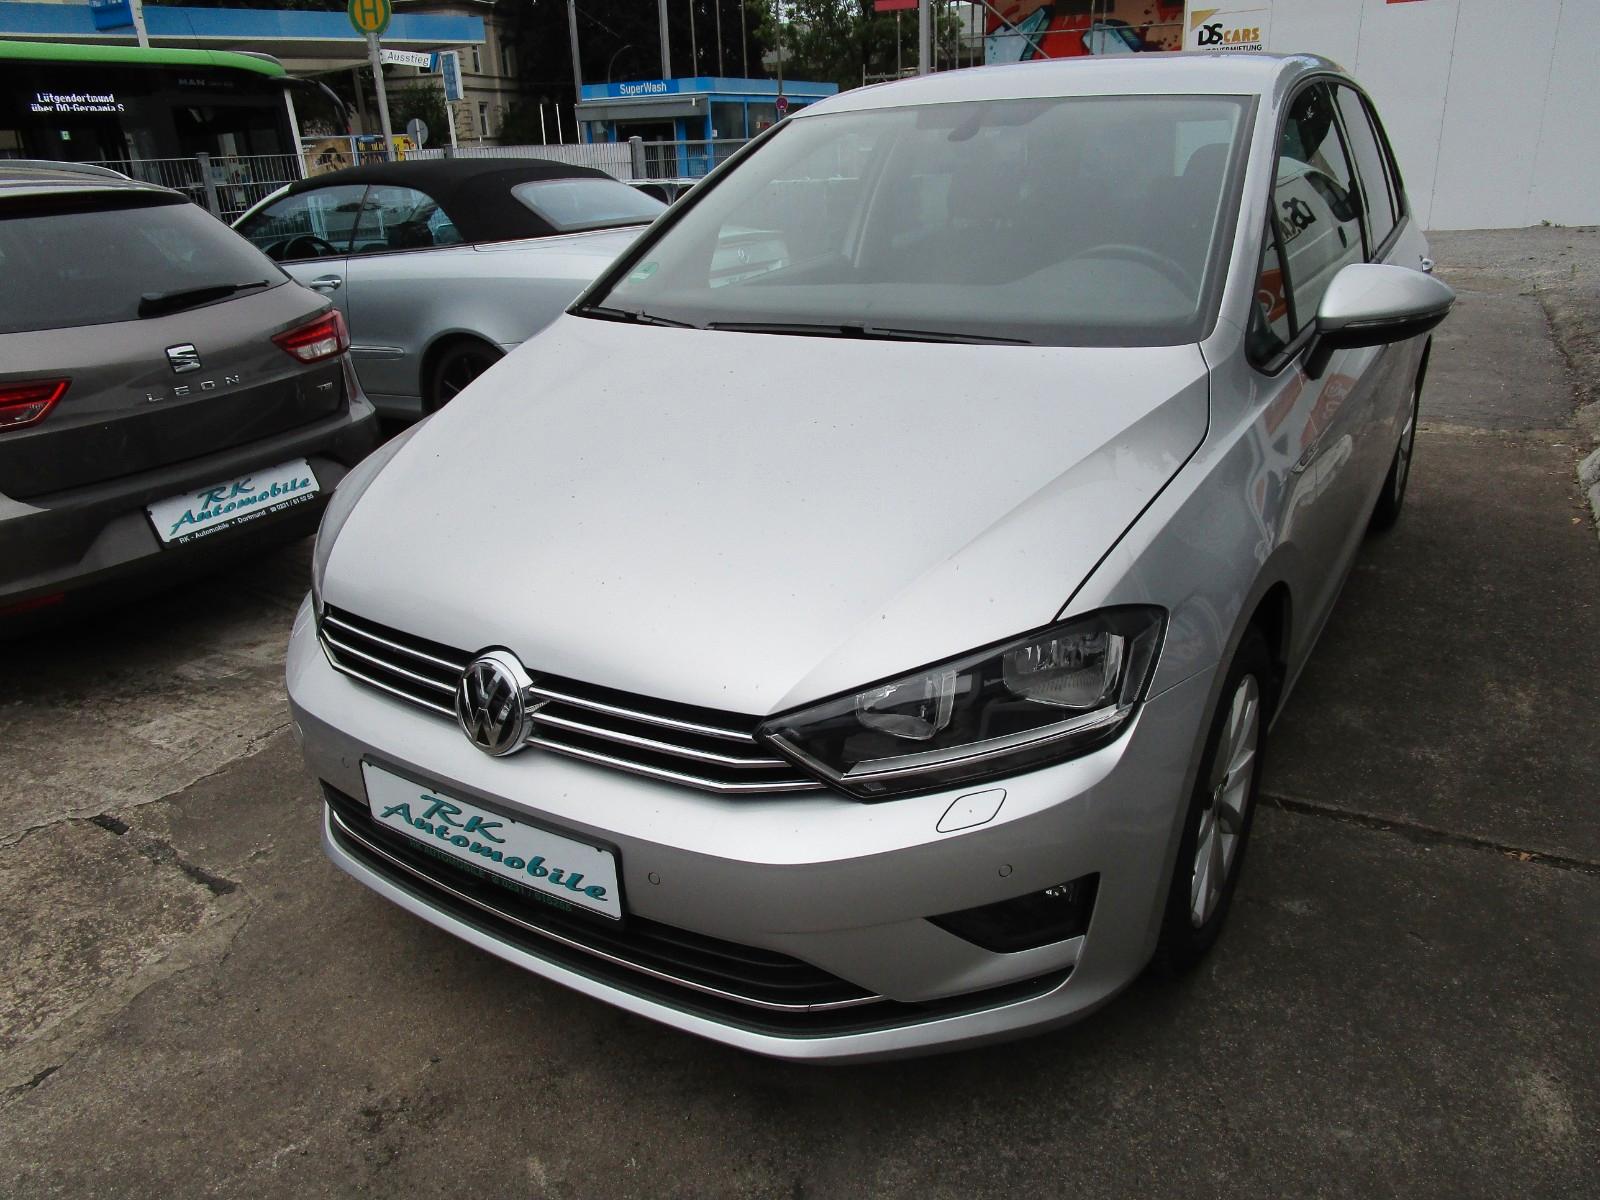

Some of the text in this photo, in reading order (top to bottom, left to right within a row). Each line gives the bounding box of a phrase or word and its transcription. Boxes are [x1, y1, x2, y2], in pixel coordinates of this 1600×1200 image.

[388, 51, 430, 67] Ausstieg
[37, 93, 116, 104] Lütgendortmund
[619, 82, 667, 97] SuperWash
[31, 103, 54, 112] über
[146, 374, 240, 402] LEON
[170, 477, 311, 536] Automobile
[198, 477, 255, 511] RK
[178, 535, 190, 545] RK
[195, 522, 230, 539] Automobile
[236, 510, 267, 524] Dortmund
[420, 793, 506, 844] RK
[379, 802, 609, 901] Automobile
